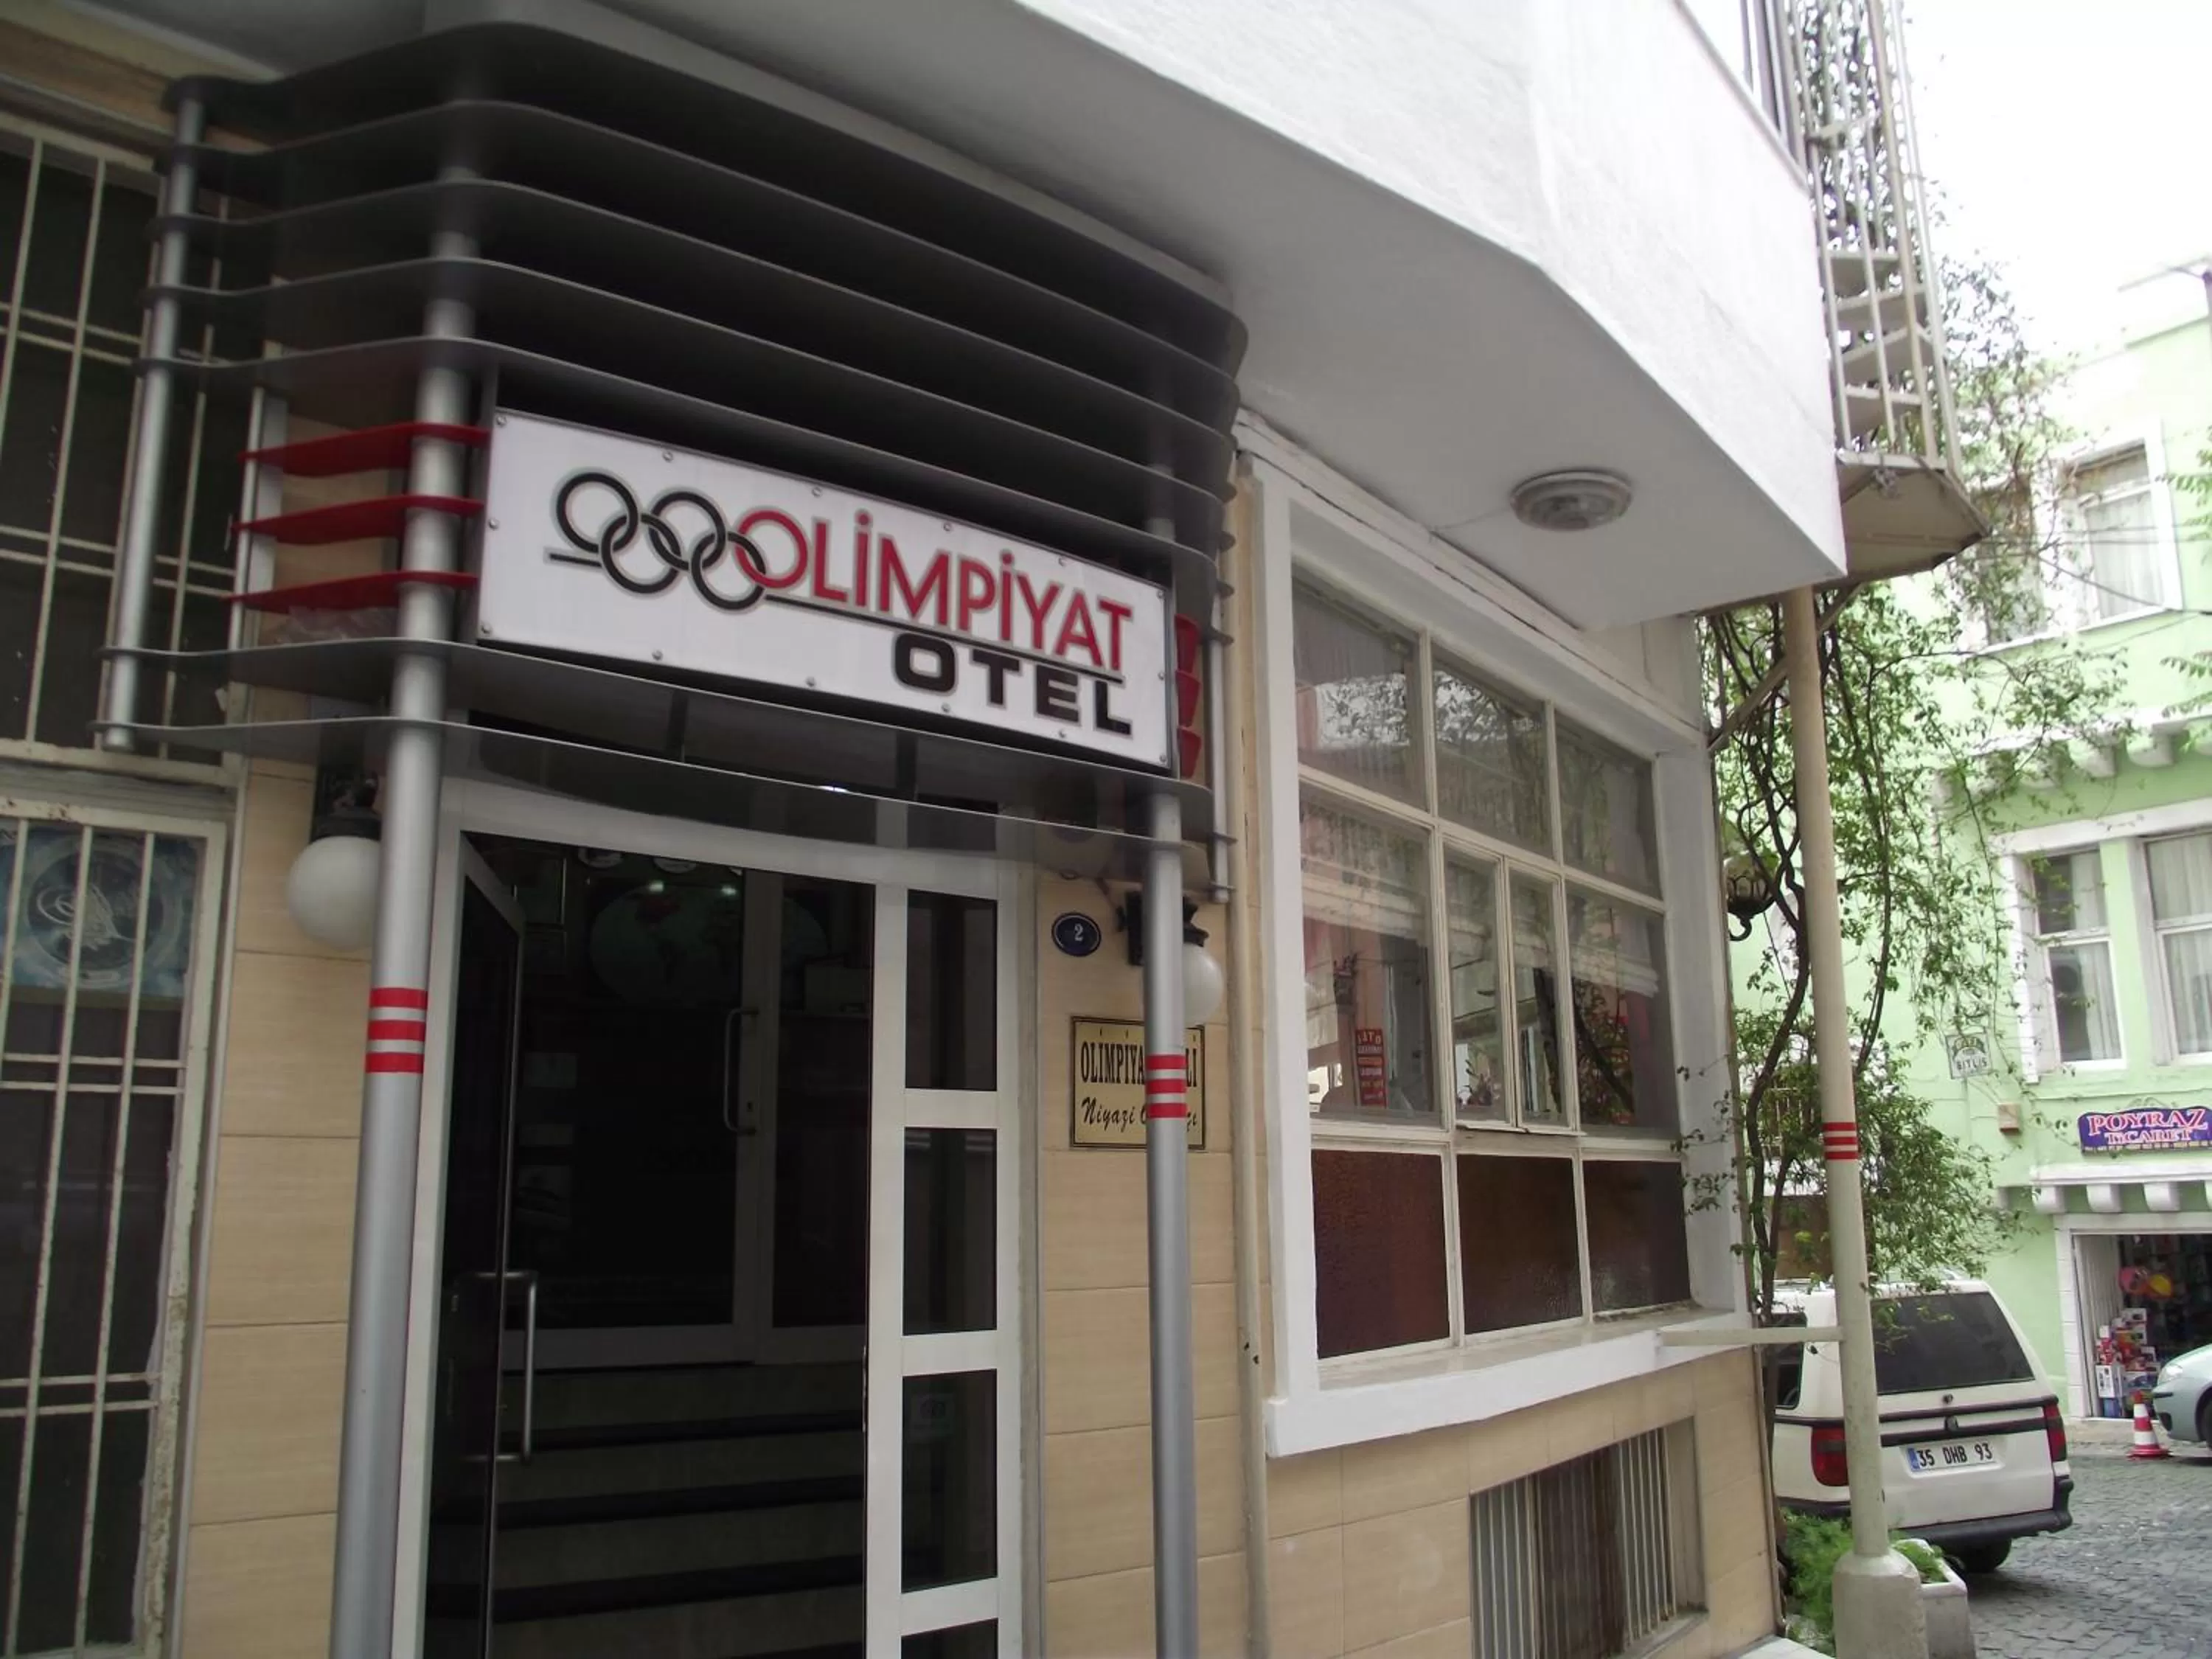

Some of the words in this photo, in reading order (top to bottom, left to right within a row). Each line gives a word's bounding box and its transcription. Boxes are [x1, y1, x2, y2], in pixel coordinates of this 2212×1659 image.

[734, 509, 1133, 670] OLİMPİYAT
[894, 633, 1131, 735] OTEL
[1074, 923, 1084, 942] 2
[1081, 1096, 1135, 1133] Niyazi
[2087, 1108, 2208, 1135] POYRAZ
[1916, 1449, 1935, 1467] 35
[1942, 1445, 1967, 1464] DHB
[1974, 1442, 1992, 1460] 93
